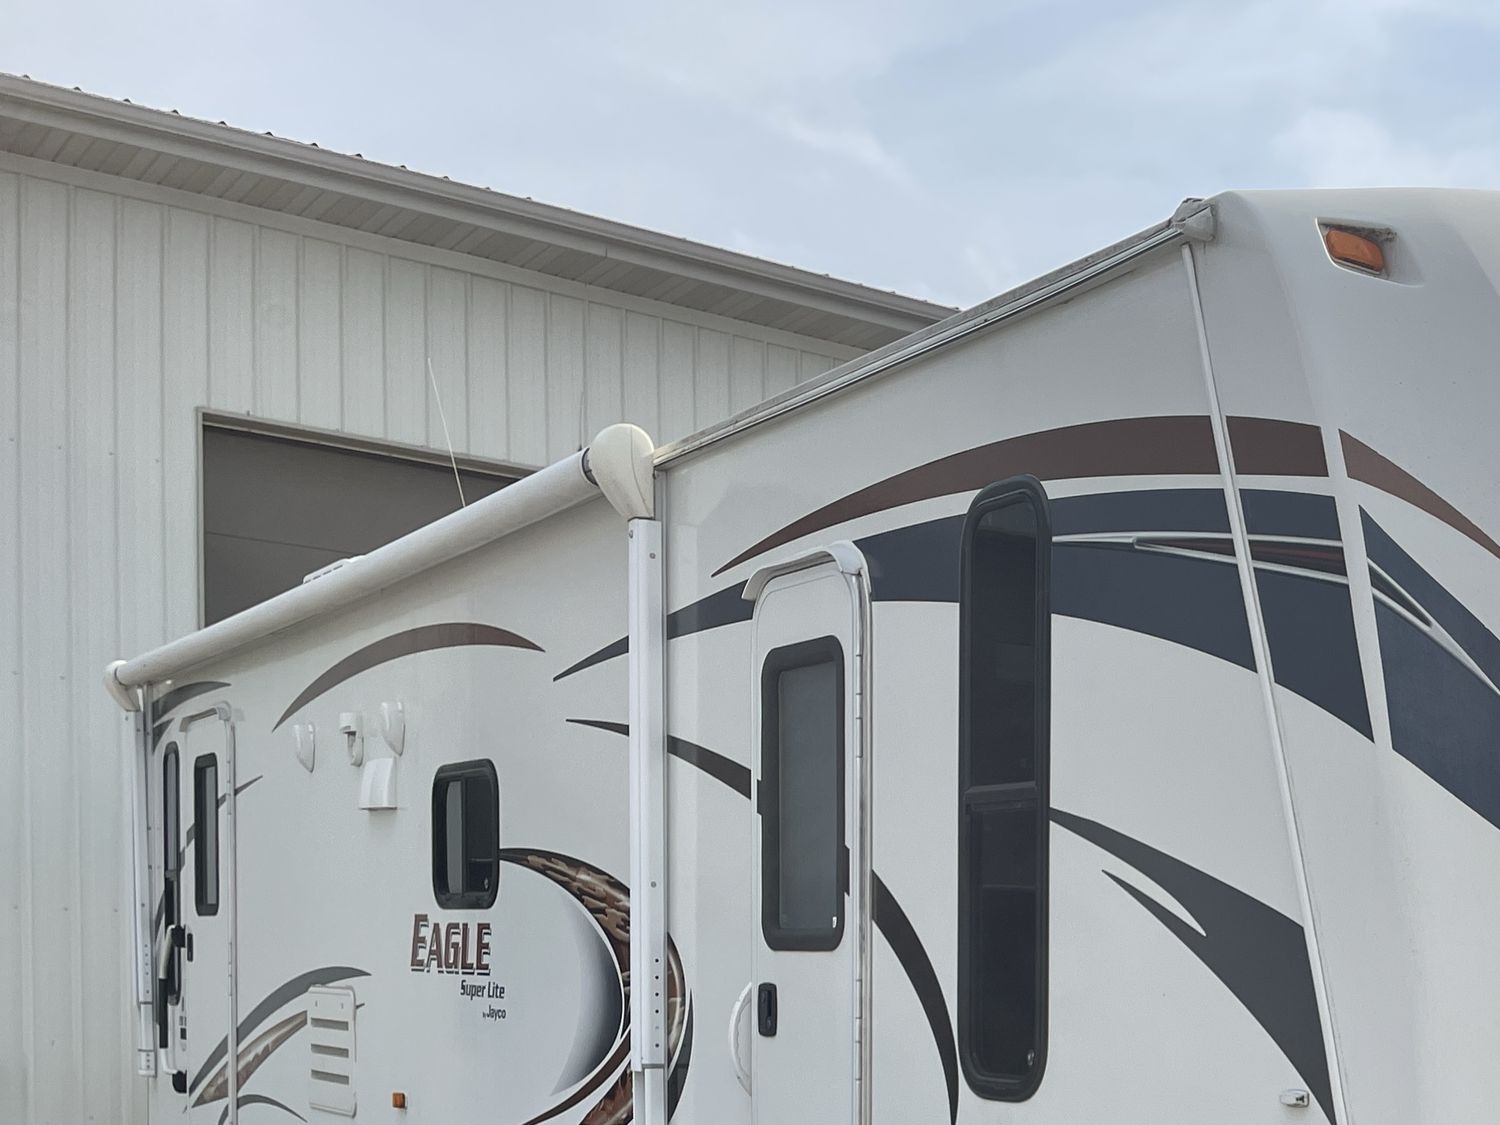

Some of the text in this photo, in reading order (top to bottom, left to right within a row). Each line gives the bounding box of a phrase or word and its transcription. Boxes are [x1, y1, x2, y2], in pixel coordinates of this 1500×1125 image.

[410, 913, 492, 976] EAGLE
[460, 980, 505, 1000] Super Lite
[487, 1004, 507, 1021] Jayco
